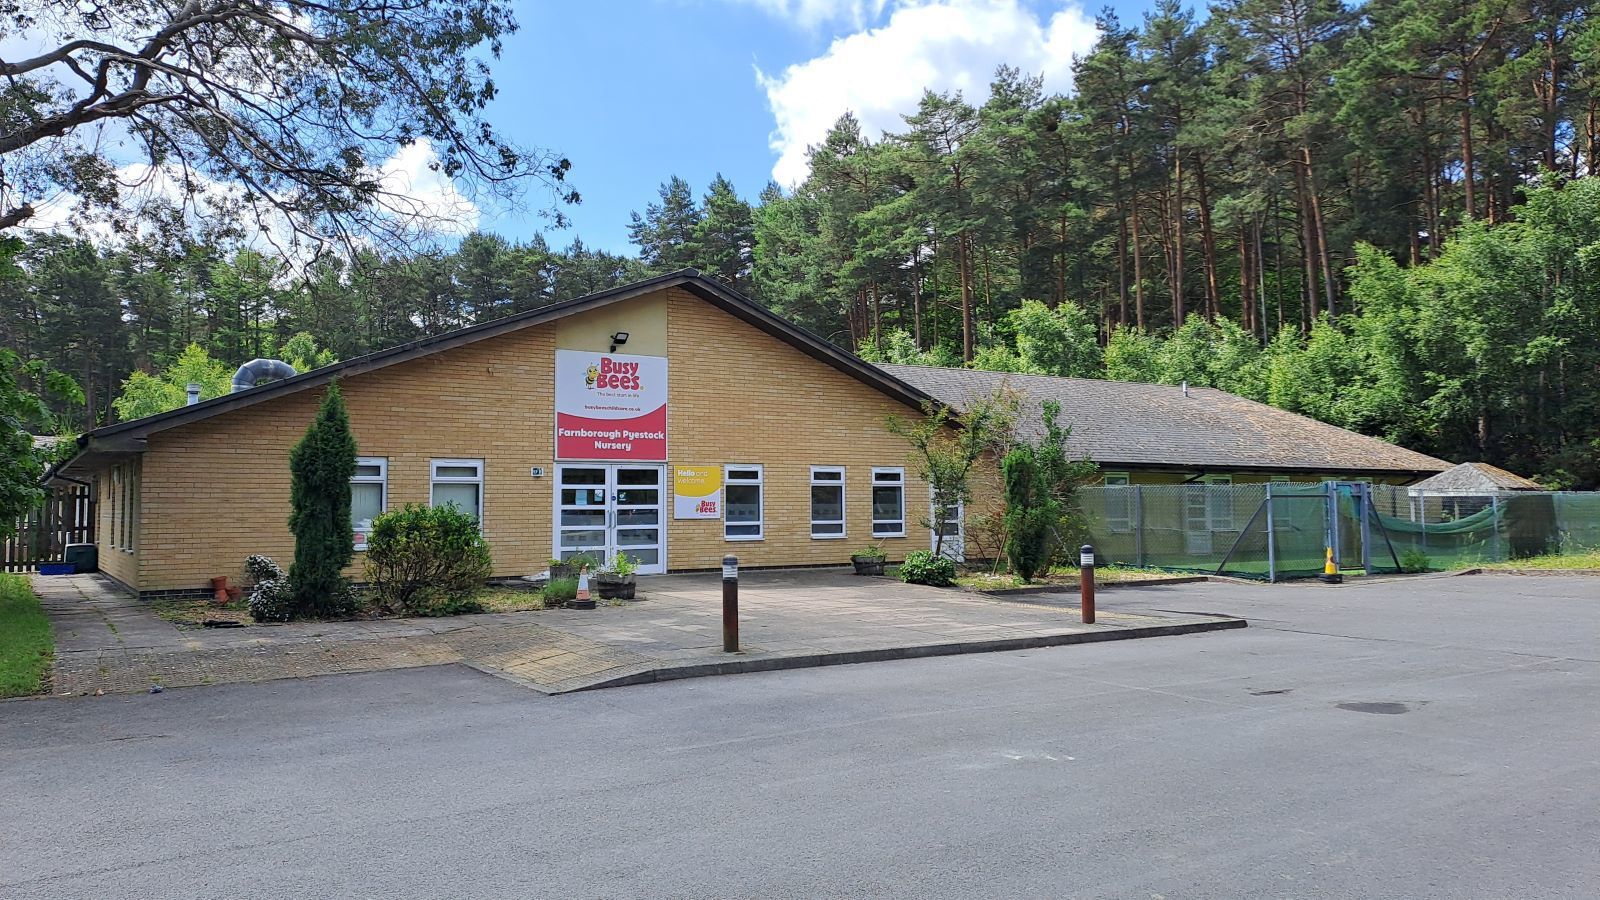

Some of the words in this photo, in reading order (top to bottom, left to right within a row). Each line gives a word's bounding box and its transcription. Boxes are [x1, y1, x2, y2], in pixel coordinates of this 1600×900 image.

[600, 357, 639, 377] Busy
[596, 374, 640, 391] Bees
[558, 428, 621, 439] Farnborough
[622, 430, 665, 440] Pyestock
[594, 440, 632, 451] Nursery
[677, 469, 695, 477] Hello
[701, 500, 716, 508] Busy
